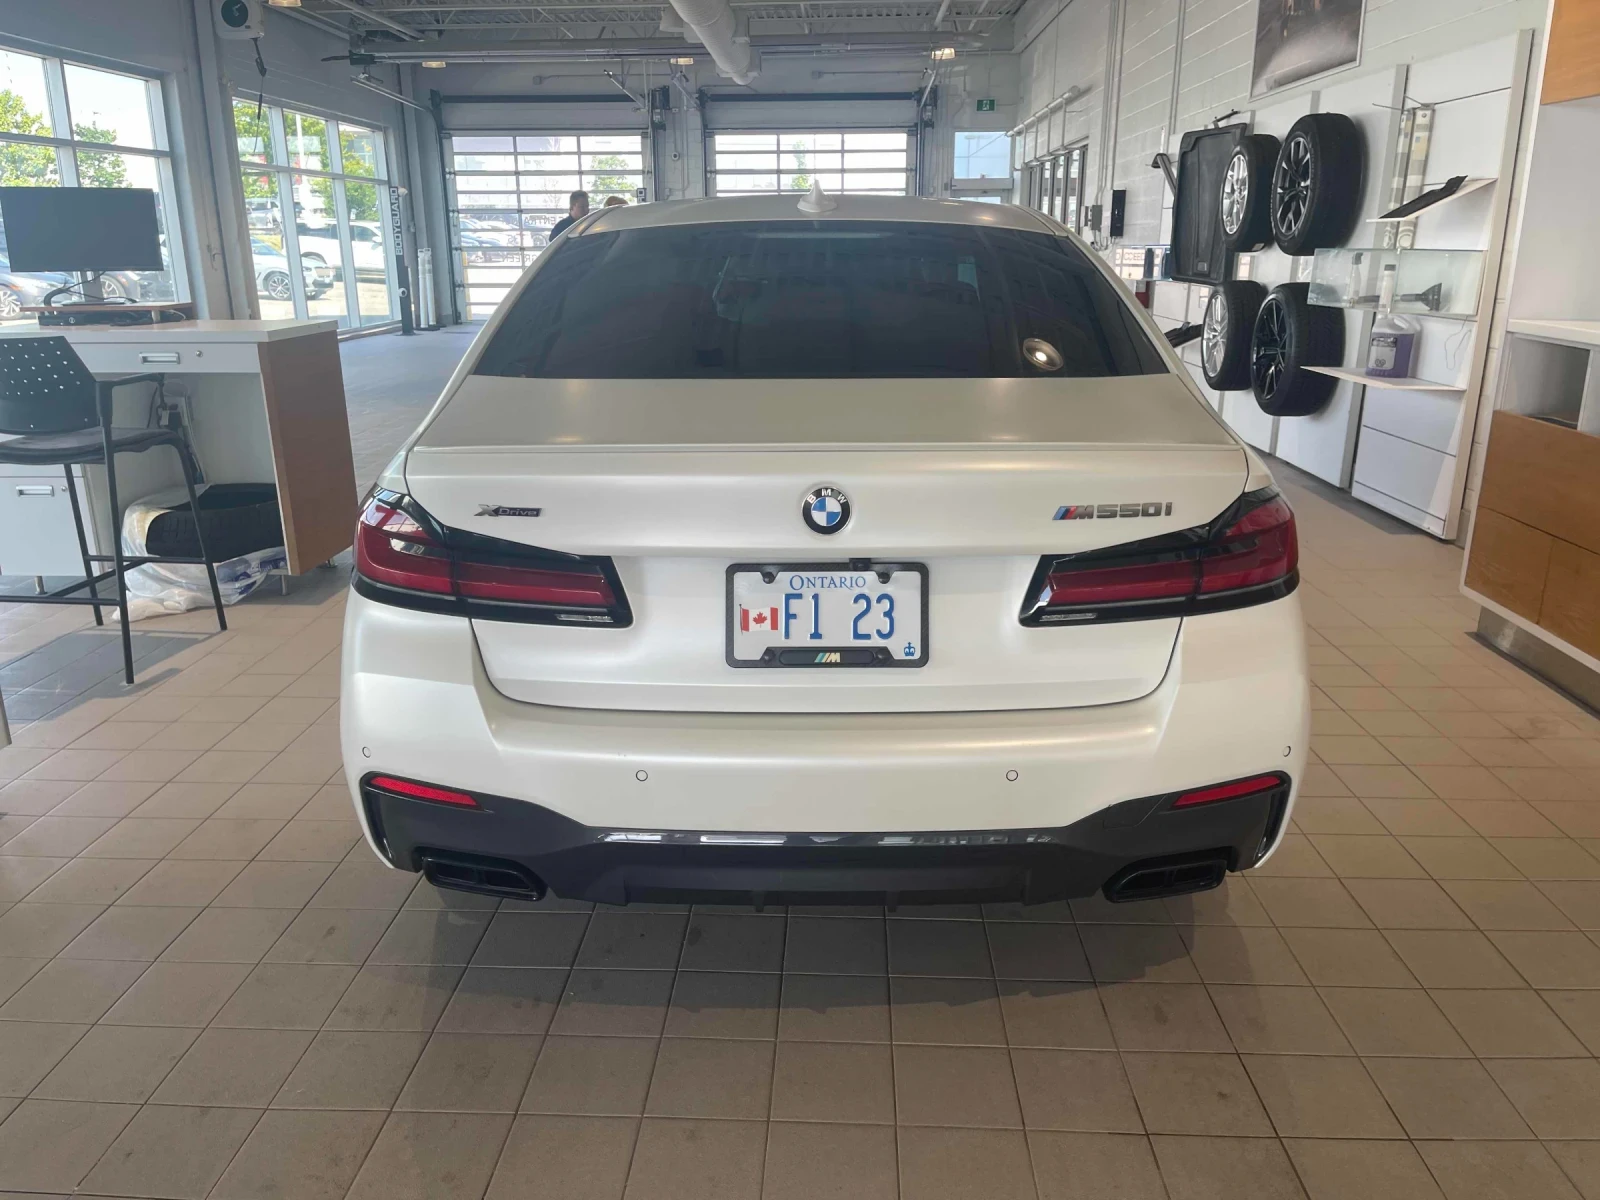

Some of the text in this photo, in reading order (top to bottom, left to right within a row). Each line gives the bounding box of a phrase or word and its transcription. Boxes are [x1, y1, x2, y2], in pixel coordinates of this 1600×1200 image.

[390, 187, 403, 256] BODYGUARD
[807, 488, 848, 504] BMW
[784, 593, 895, 640] F1 23
